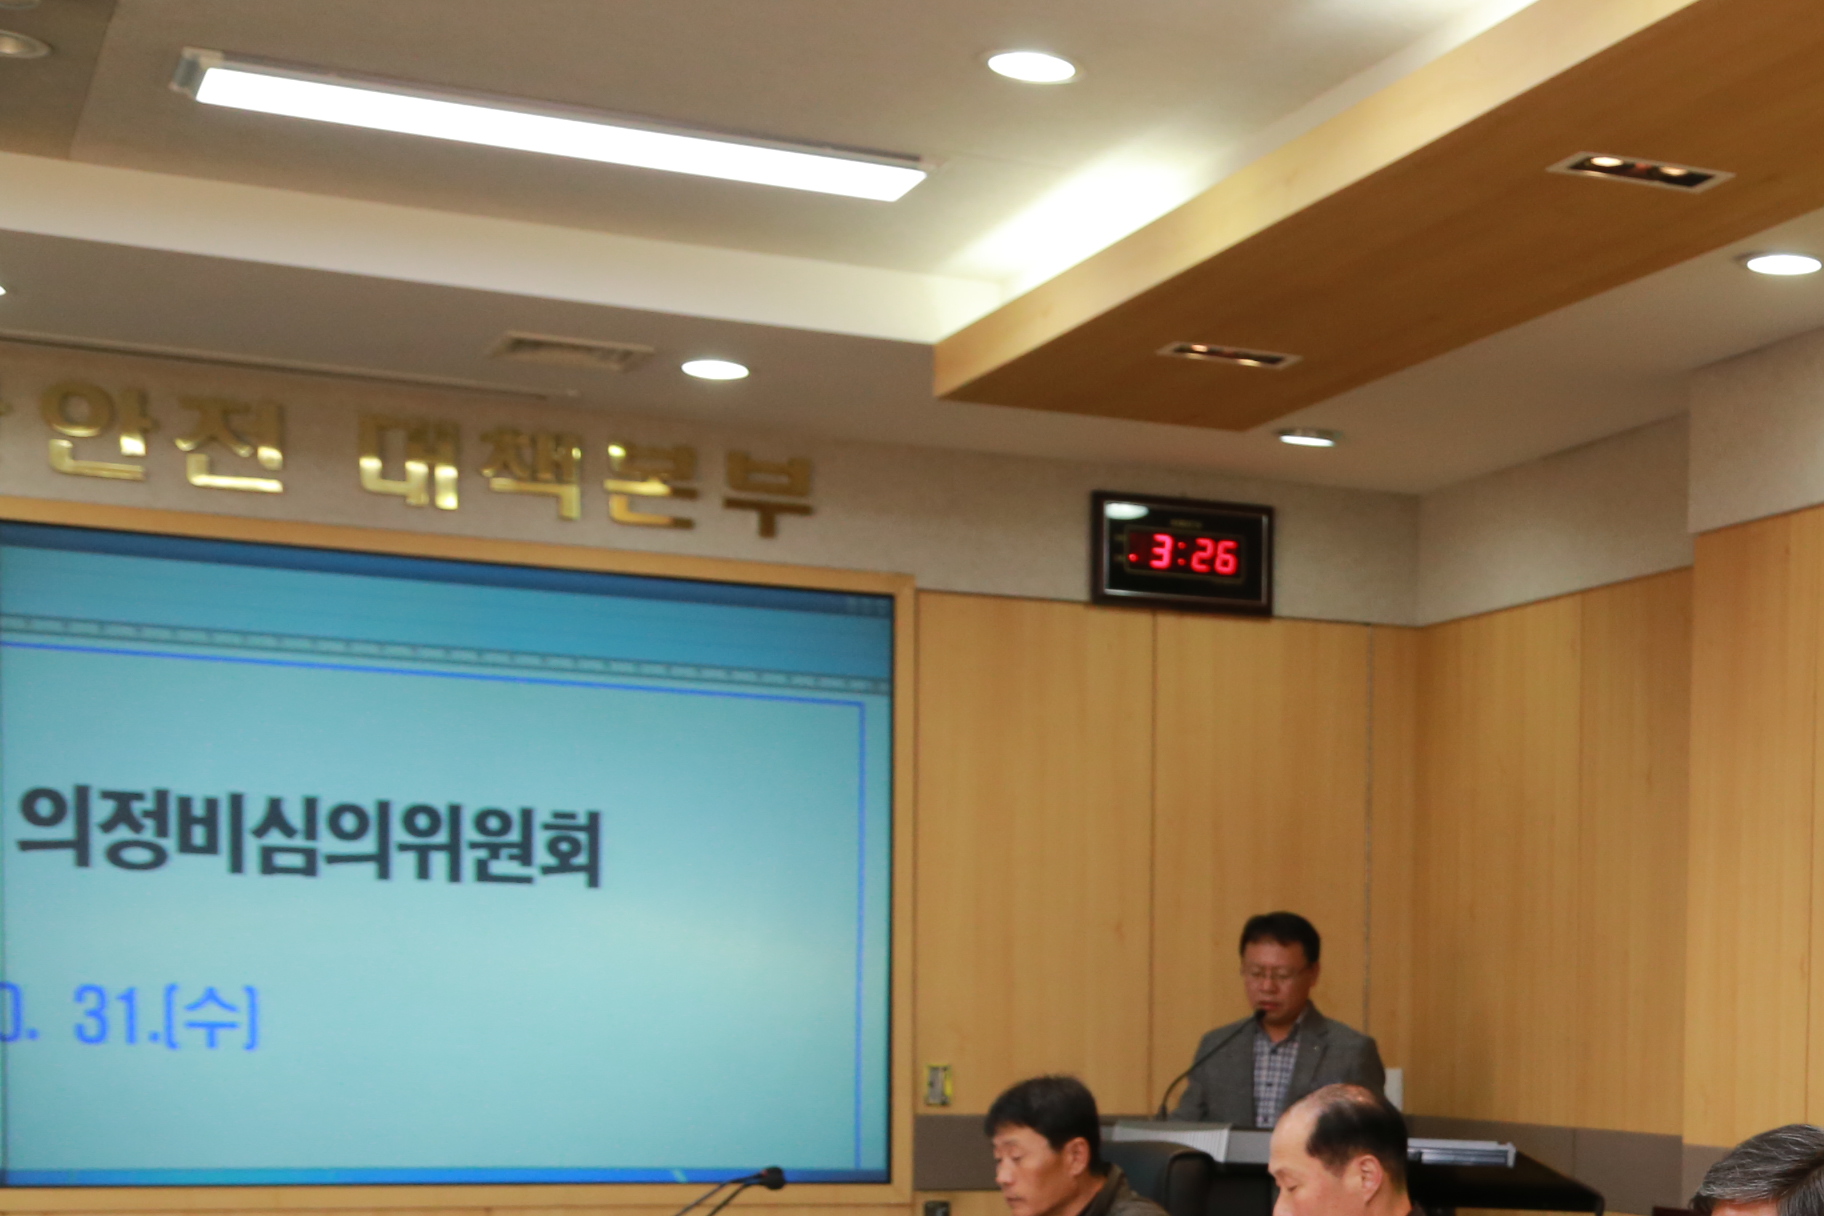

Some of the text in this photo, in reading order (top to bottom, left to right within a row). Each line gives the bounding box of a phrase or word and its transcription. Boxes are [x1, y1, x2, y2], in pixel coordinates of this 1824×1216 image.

[357, 409, 815, 540] 대책본부
[1150, 533, 1239, 575] 3:26
[16, 783, 602, 889] 의정비심의위원회
